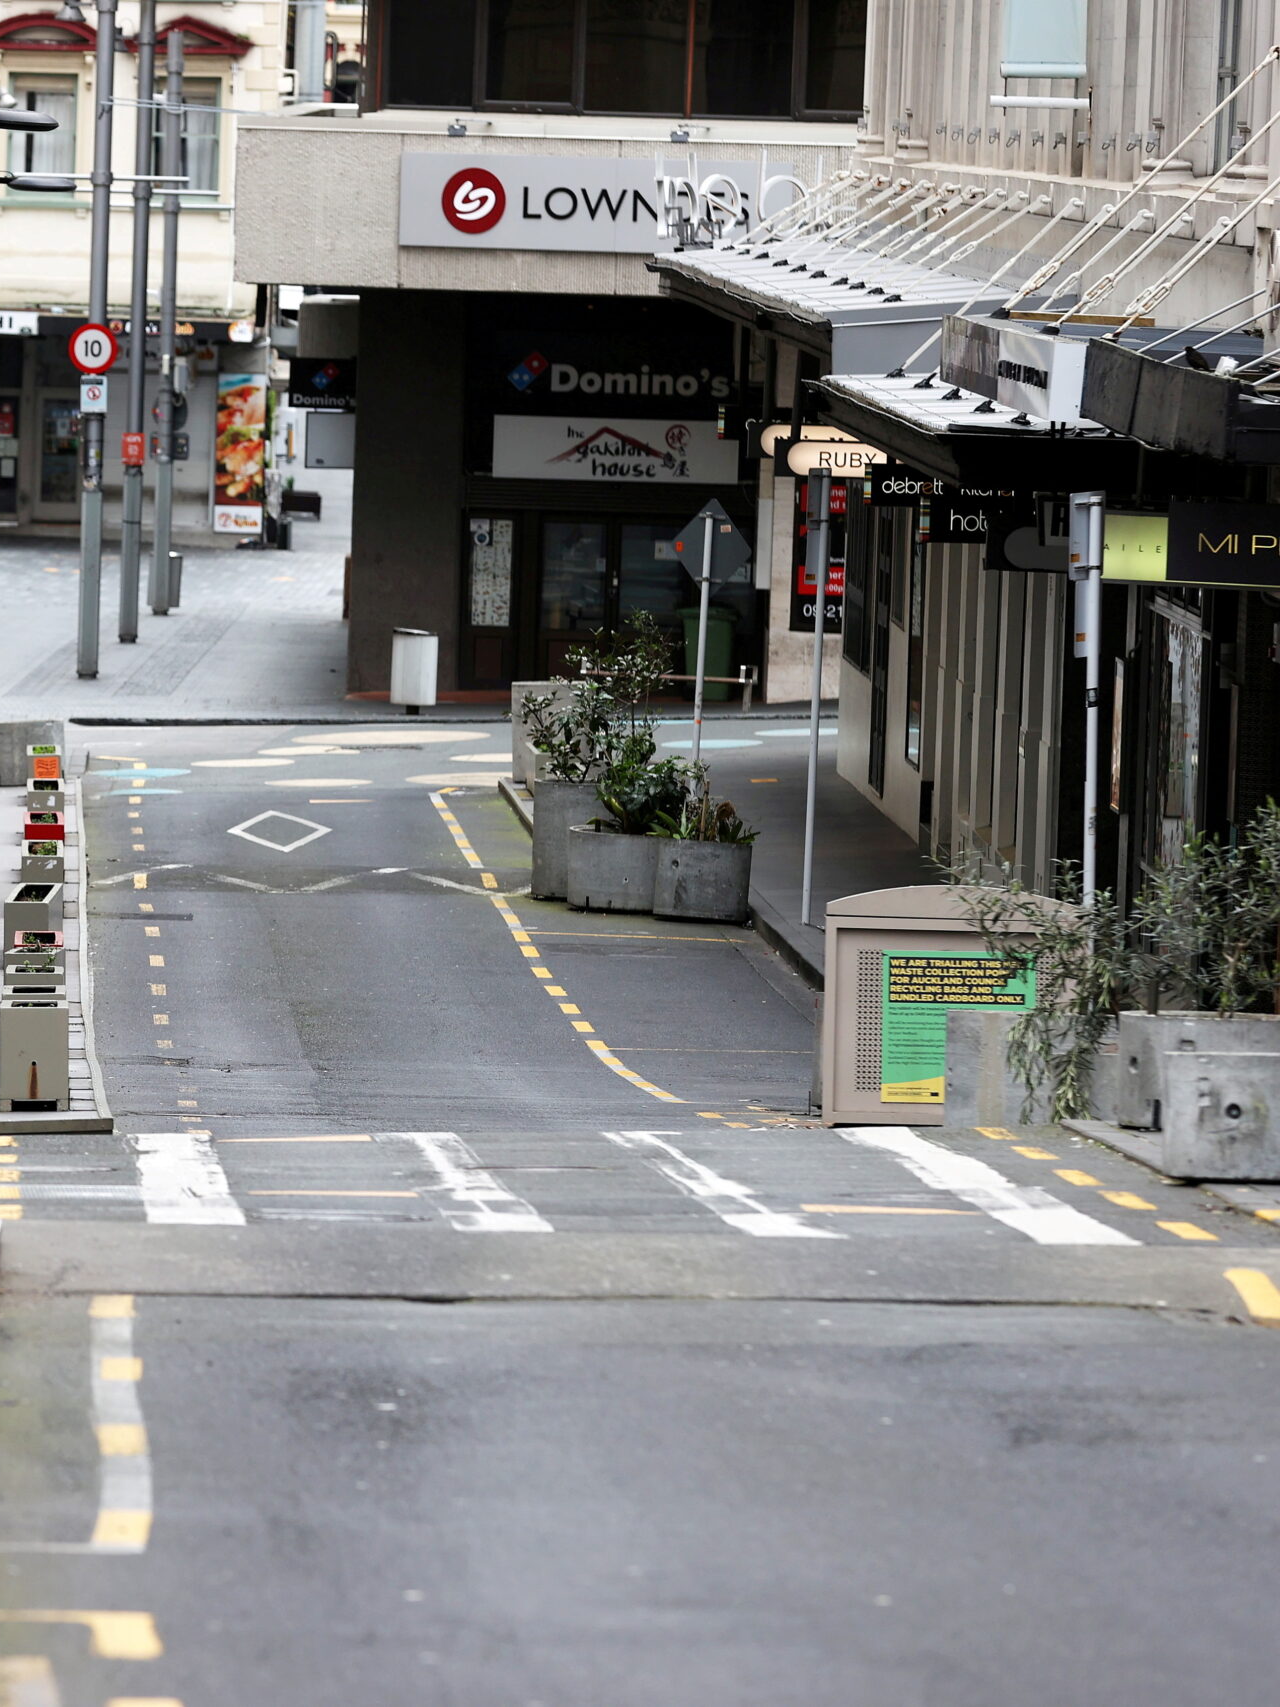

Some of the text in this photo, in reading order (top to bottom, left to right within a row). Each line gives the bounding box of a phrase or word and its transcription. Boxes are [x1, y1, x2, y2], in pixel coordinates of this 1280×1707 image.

[523, 185, 750, 223] LOWNES
[83, 339, 102, 358] 10
[592, 458, 656, 477] house
[818, 451, 877, 468] RUBY
[881, 476, 944, 495] debrett
[949, 509, 988, 532] hot
[1198, 532, 1280, 556] MI P
[890, 959, 907, 967] WE
[908, 959, 928, 967] ARE
[929, 960, 979, 968] TRIALLING
[980, 960, 1002, 968] THIS
[890, 967, 924, 976] WASTE
[924, 968, 984, 977] COLLECTION
[890, 976, 910, 984] FOR
[911, 976, 963, 985] AUCKLAND
[890, 985, 992, 994] RECYCLING BAGS AND
[890, 993, 1024, 1004] BUNDLED CARDBOARD ONLY.
